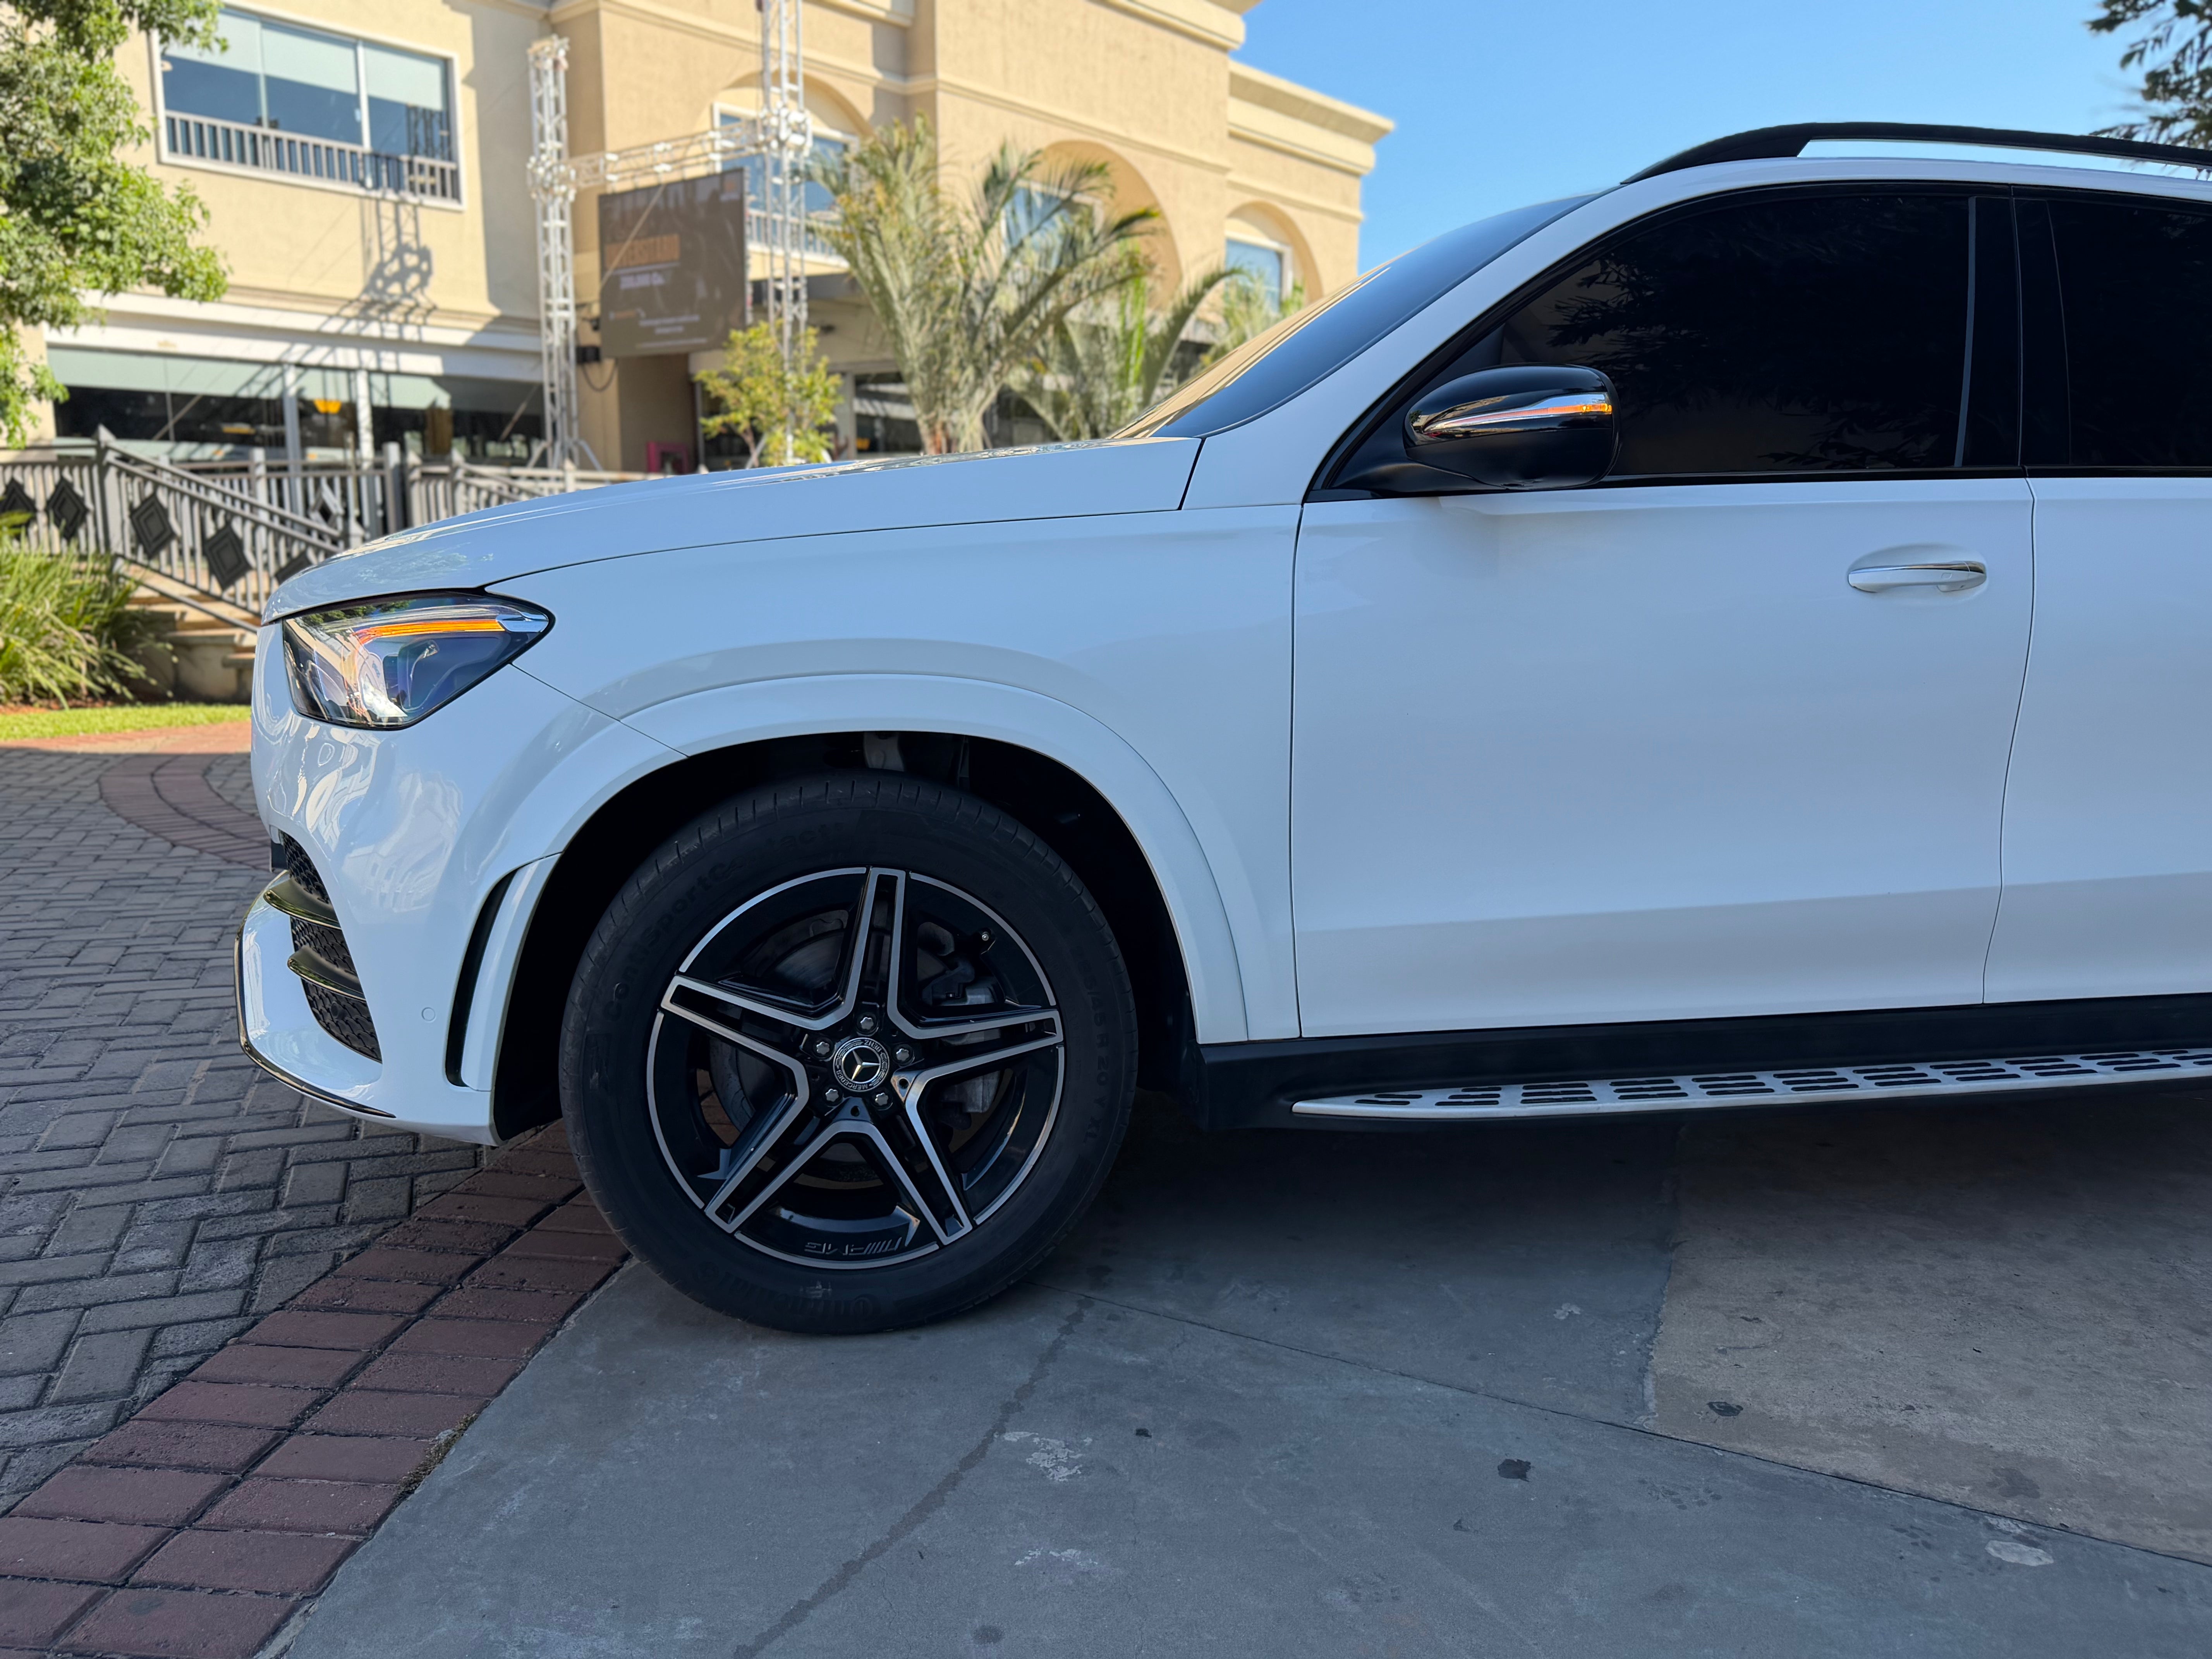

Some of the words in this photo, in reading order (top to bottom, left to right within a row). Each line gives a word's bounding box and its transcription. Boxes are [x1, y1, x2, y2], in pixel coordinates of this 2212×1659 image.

[602, 823, 833, 1022] ContiSportCotact
[864, 1039, 882, 1052] BENZ
[1096, 1033, 1110, 1048] R
[836, 1070, 868, 1090] MERCEDES
[1096, 1055, 1110, 1086] 20
[1082, 1115, 1103, 1144] XL
[804, 1241, 872, 1255] AMG
